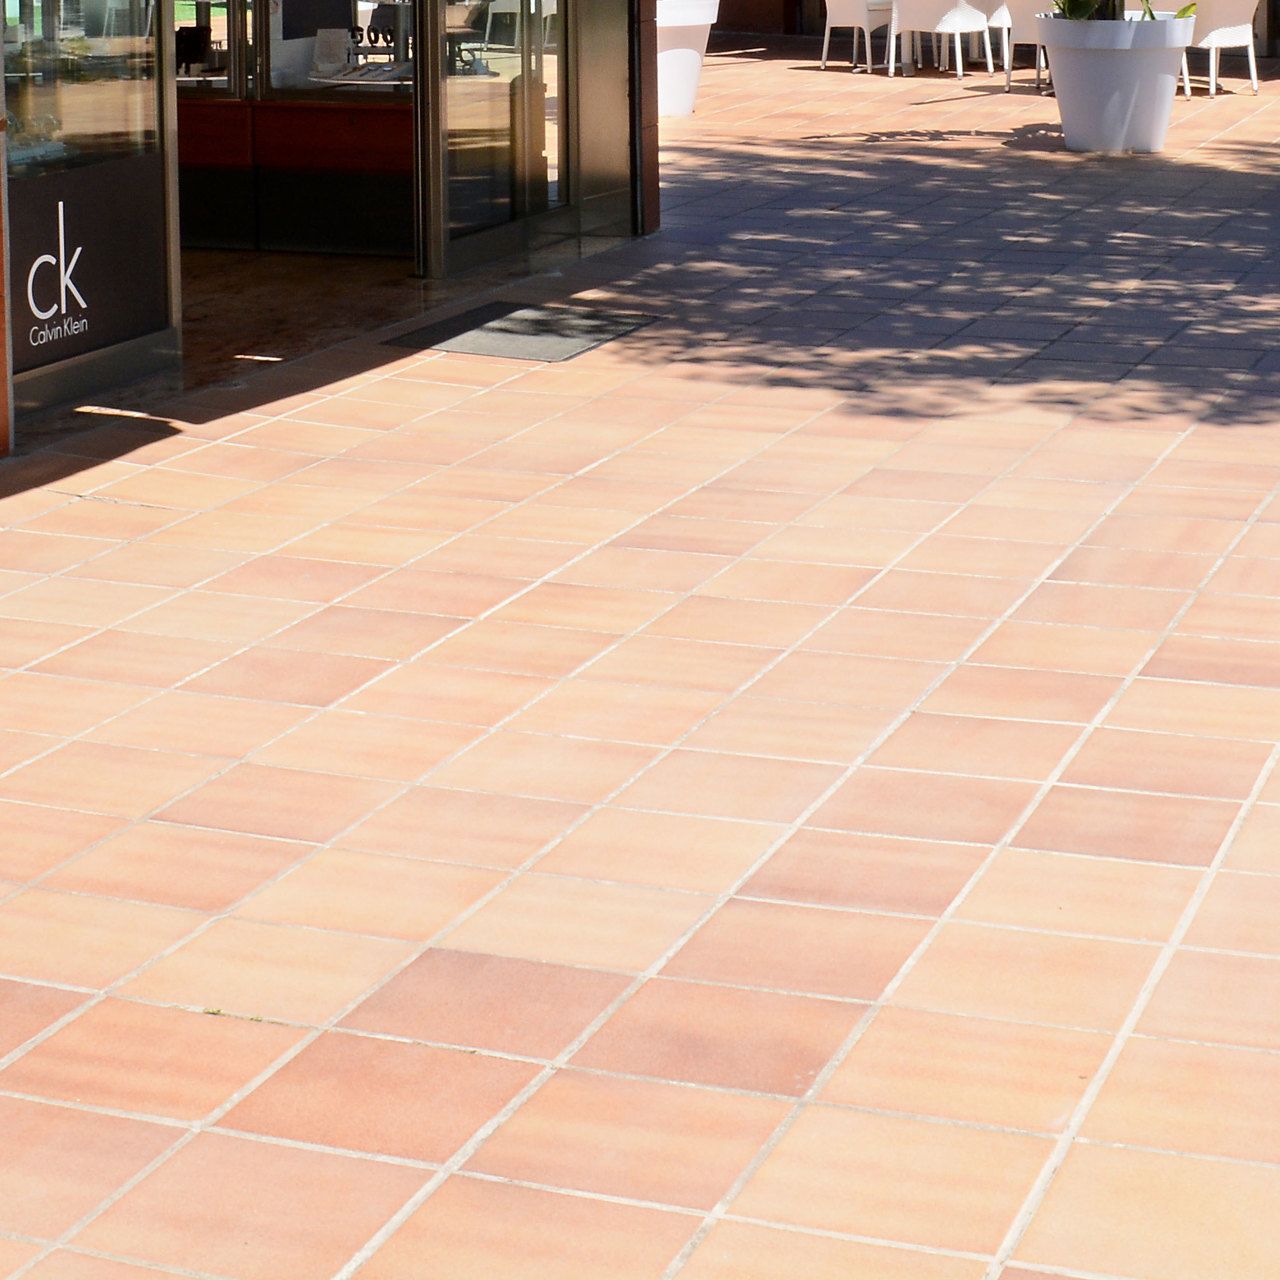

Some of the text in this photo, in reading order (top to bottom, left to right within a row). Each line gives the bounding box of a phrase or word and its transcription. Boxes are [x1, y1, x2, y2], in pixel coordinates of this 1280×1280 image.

[27, 201, 88, 319] ck
[29, 314, 88, 346] Calvin Klein
